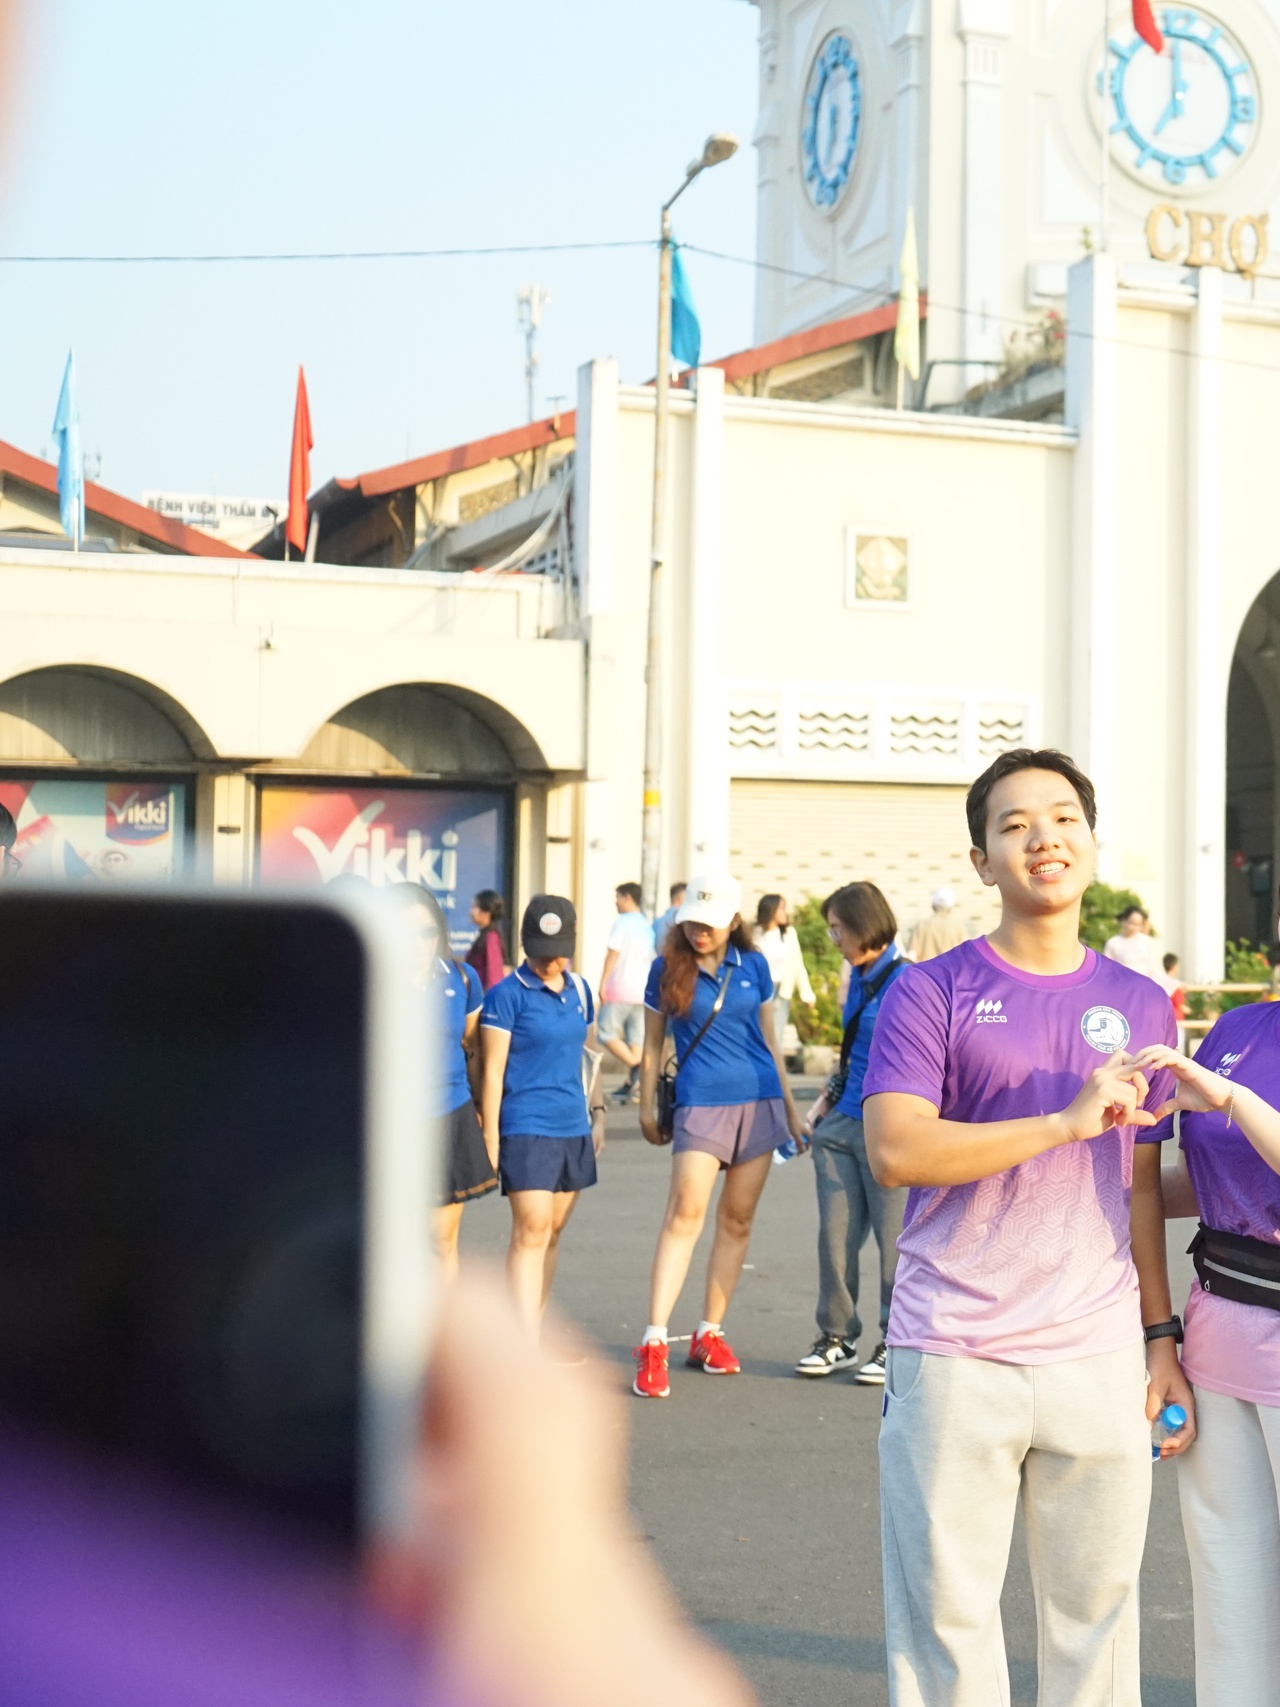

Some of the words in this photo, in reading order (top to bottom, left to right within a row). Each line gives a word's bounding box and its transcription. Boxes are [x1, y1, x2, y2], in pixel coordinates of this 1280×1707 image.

[1144, 203, 1270, 281] CHỢ
[107, 791, 168, 825] Vikki
[293, 799, 460, 891] Vikki
[975, 1015, 1008, 1024] ZICCO
